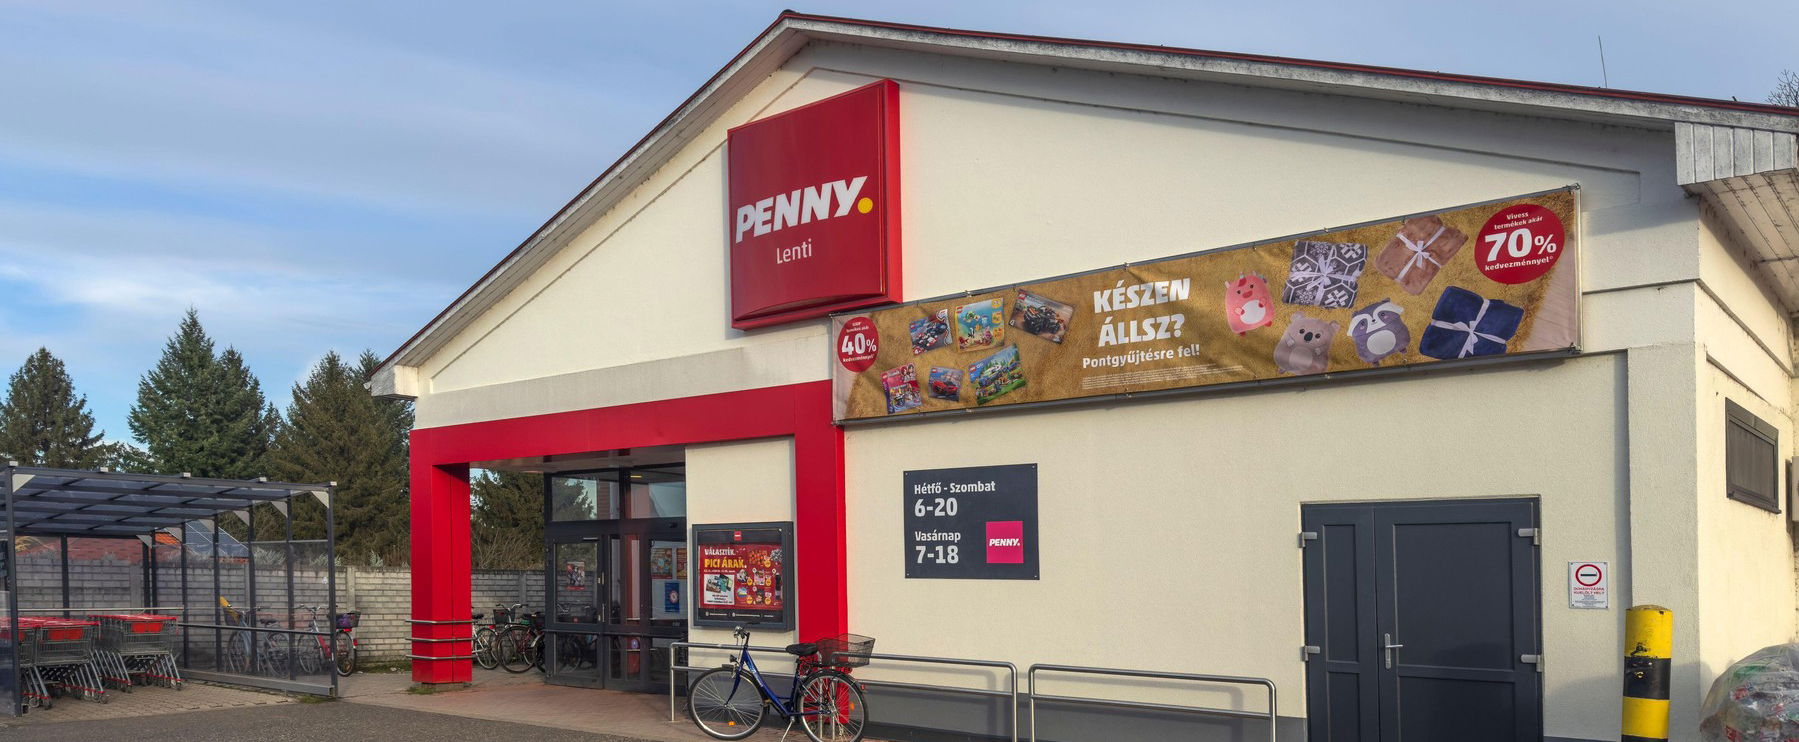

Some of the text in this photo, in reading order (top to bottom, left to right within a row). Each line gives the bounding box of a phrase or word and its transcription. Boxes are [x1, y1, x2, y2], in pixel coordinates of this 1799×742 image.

[736, 176, 873, 243] PENNY.
[1506, 212, 1529, 220] Vivess
[1494, 215, 1543, 230] termékek akár
[776, 238, 812, 264] Lenti
[1484, 228, 1557, 262] 70%
[1093, 278, 1190, 313] KÉSZEN
[1098, 313, 1185, 347] ÁLLSZ?
[841, 333, 877, 355] 40%
[1082, 344, 1200, 369] Pontgyűjtésre fel!
[914, 482, 942, 494] Hétfő
[950, 481, 996, 493] Szombat
[914, 497, 958, 517] 6-20
[915, 530, 961, 543] Vasárnap
[704, 558, 720, 568] PICI
[915, 545, 959, 564] 7-18
